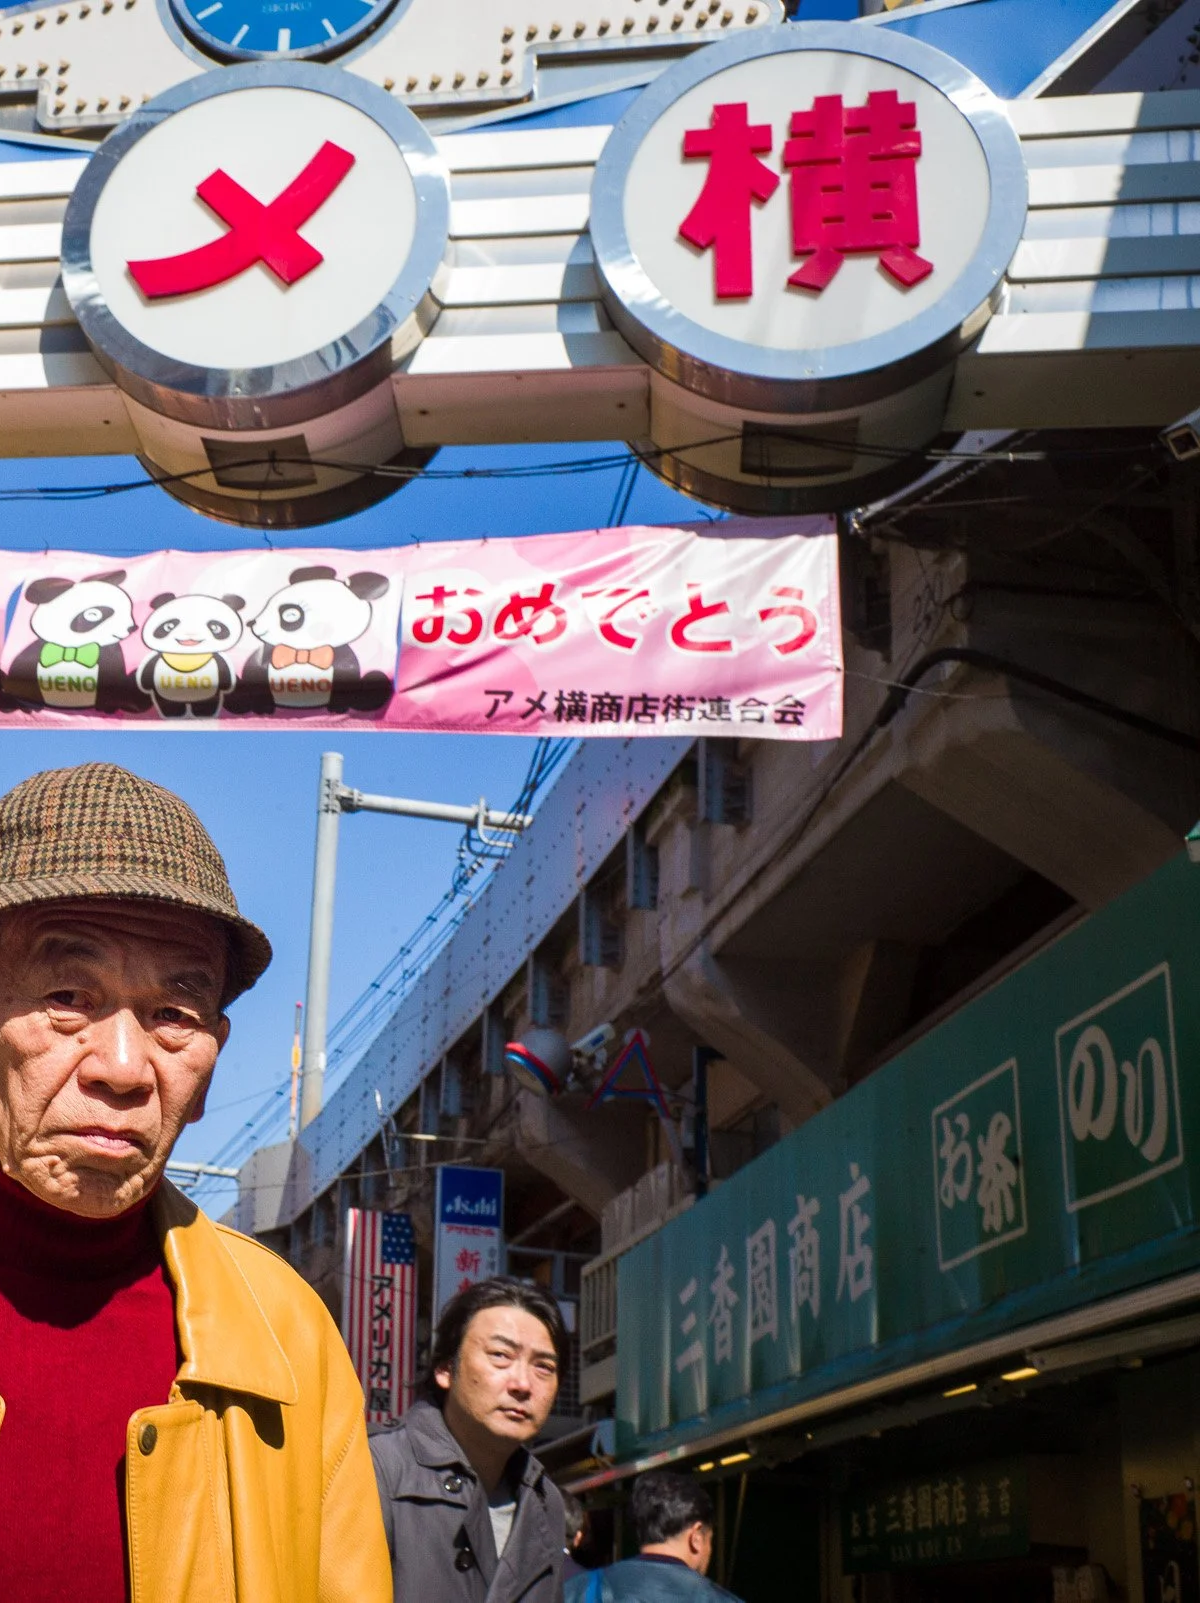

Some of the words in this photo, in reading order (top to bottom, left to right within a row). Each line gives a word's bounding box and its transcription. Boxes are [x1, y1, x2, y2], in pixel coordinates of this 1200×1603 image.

[411, 582, 819, 656] おめでとう
[40, 675, 98, 694] UENO
[159, 674, 213, 691] UENO
[270, 677, 333, 695] UENO
[484, 689, 806, 726] アメ横商店街連合会
[1068, 1024, 1168, 1163] のり
[938, 1111, 1018, 1234] お茶
[676, 1161, 874, 1374] 三香園商店
[369, 1274, 394, 1412] アメリカ屋
